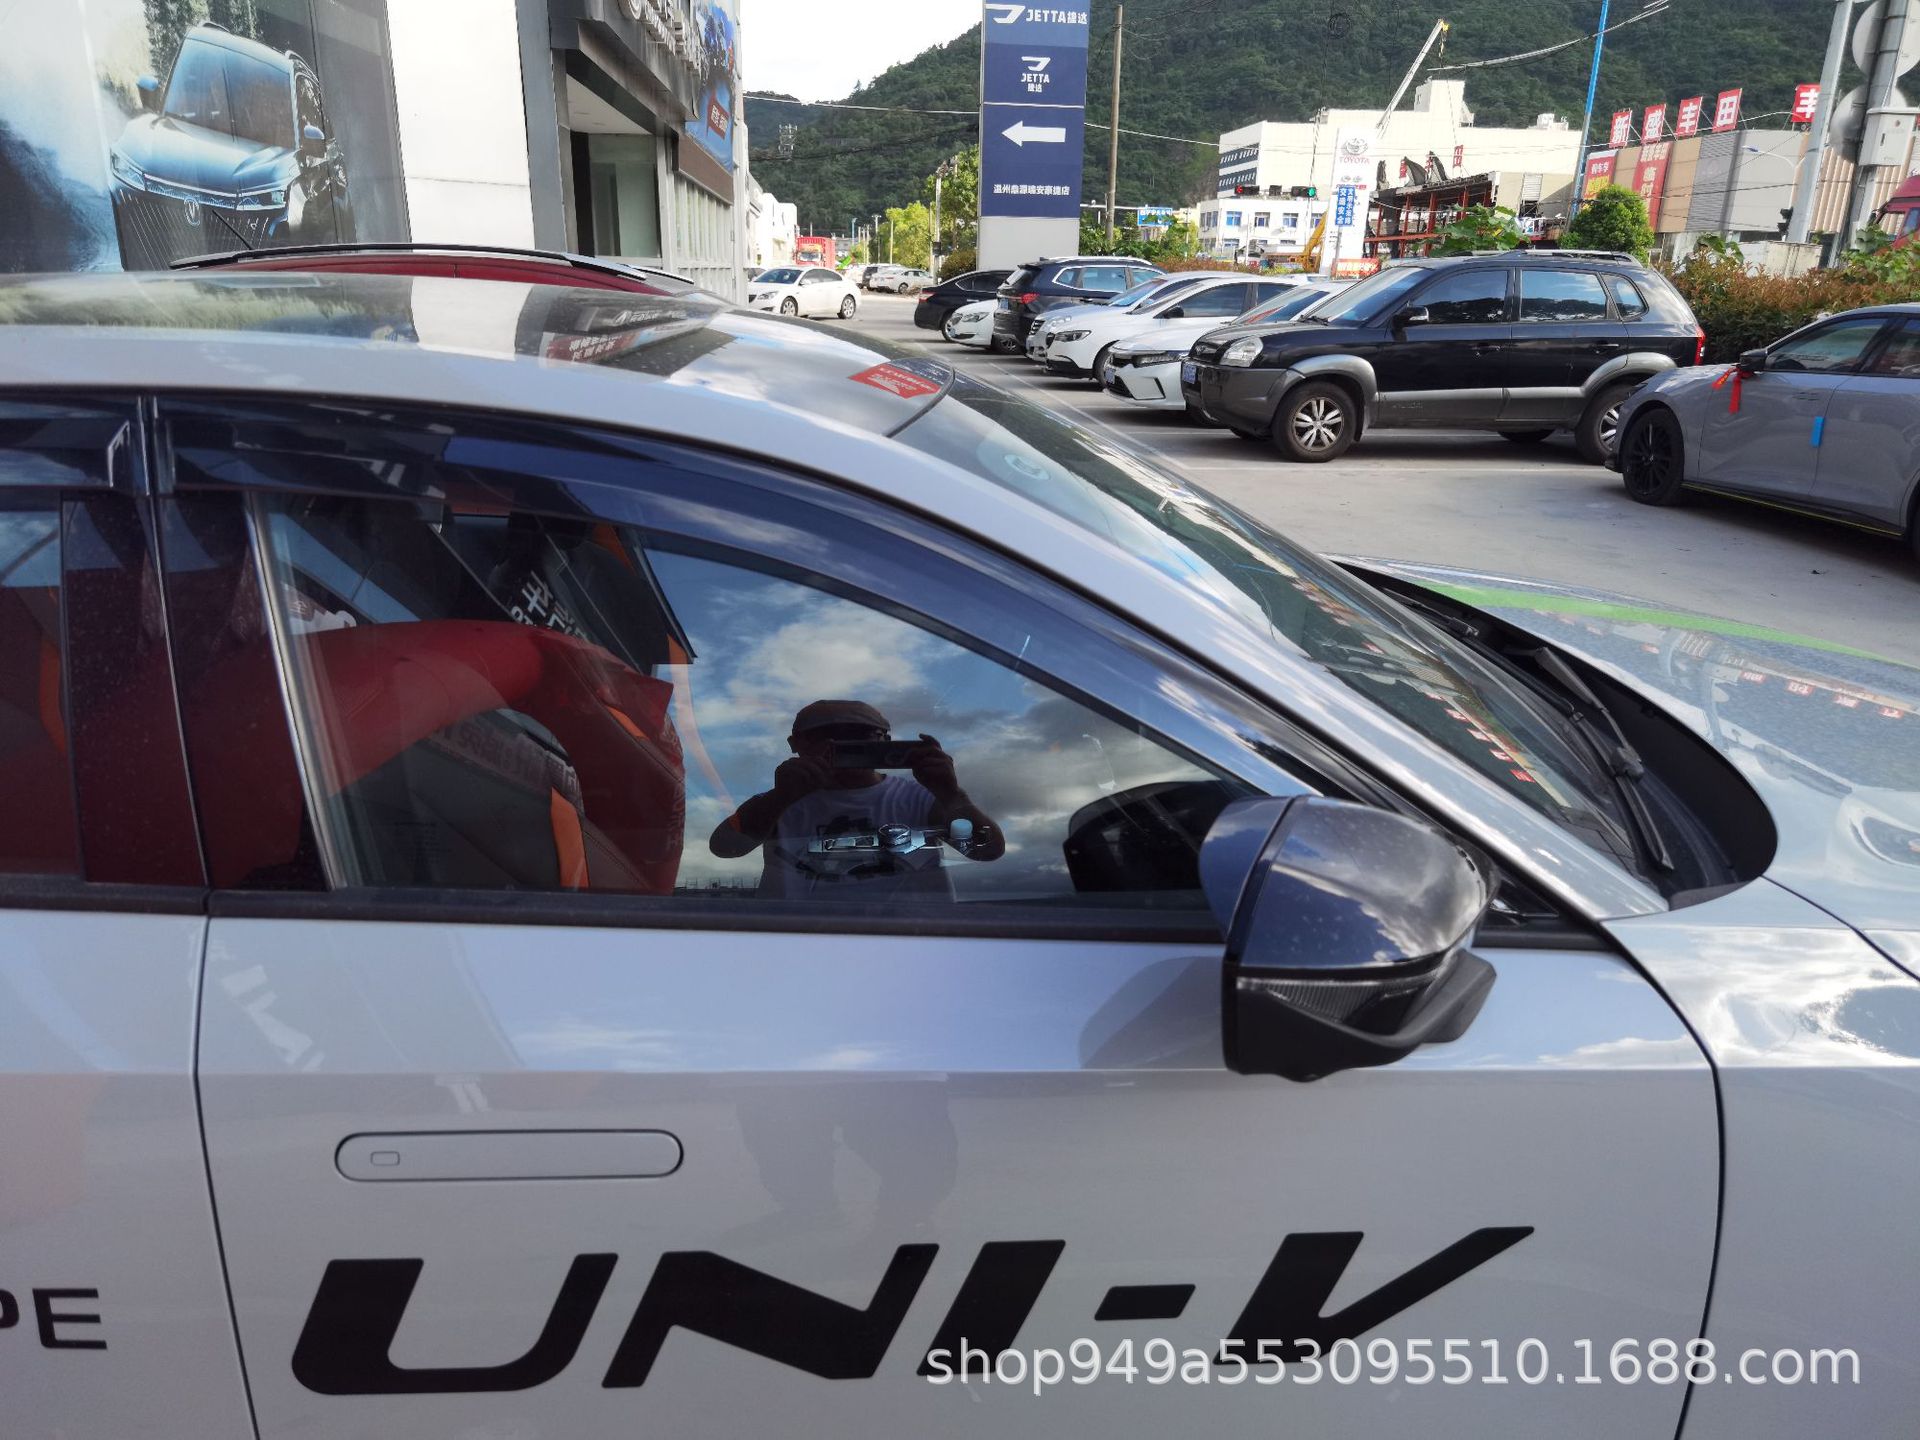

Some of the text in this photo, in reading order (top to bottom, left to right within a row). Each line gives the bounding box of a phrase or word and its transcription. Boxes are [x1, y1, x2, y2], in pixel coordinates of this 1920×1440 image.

[1020, 73, 1050, 83] JETTA
[1340, 156, 1370, 164] TOYOTA
[292, 1225, 1534, 1395] UNI-V
